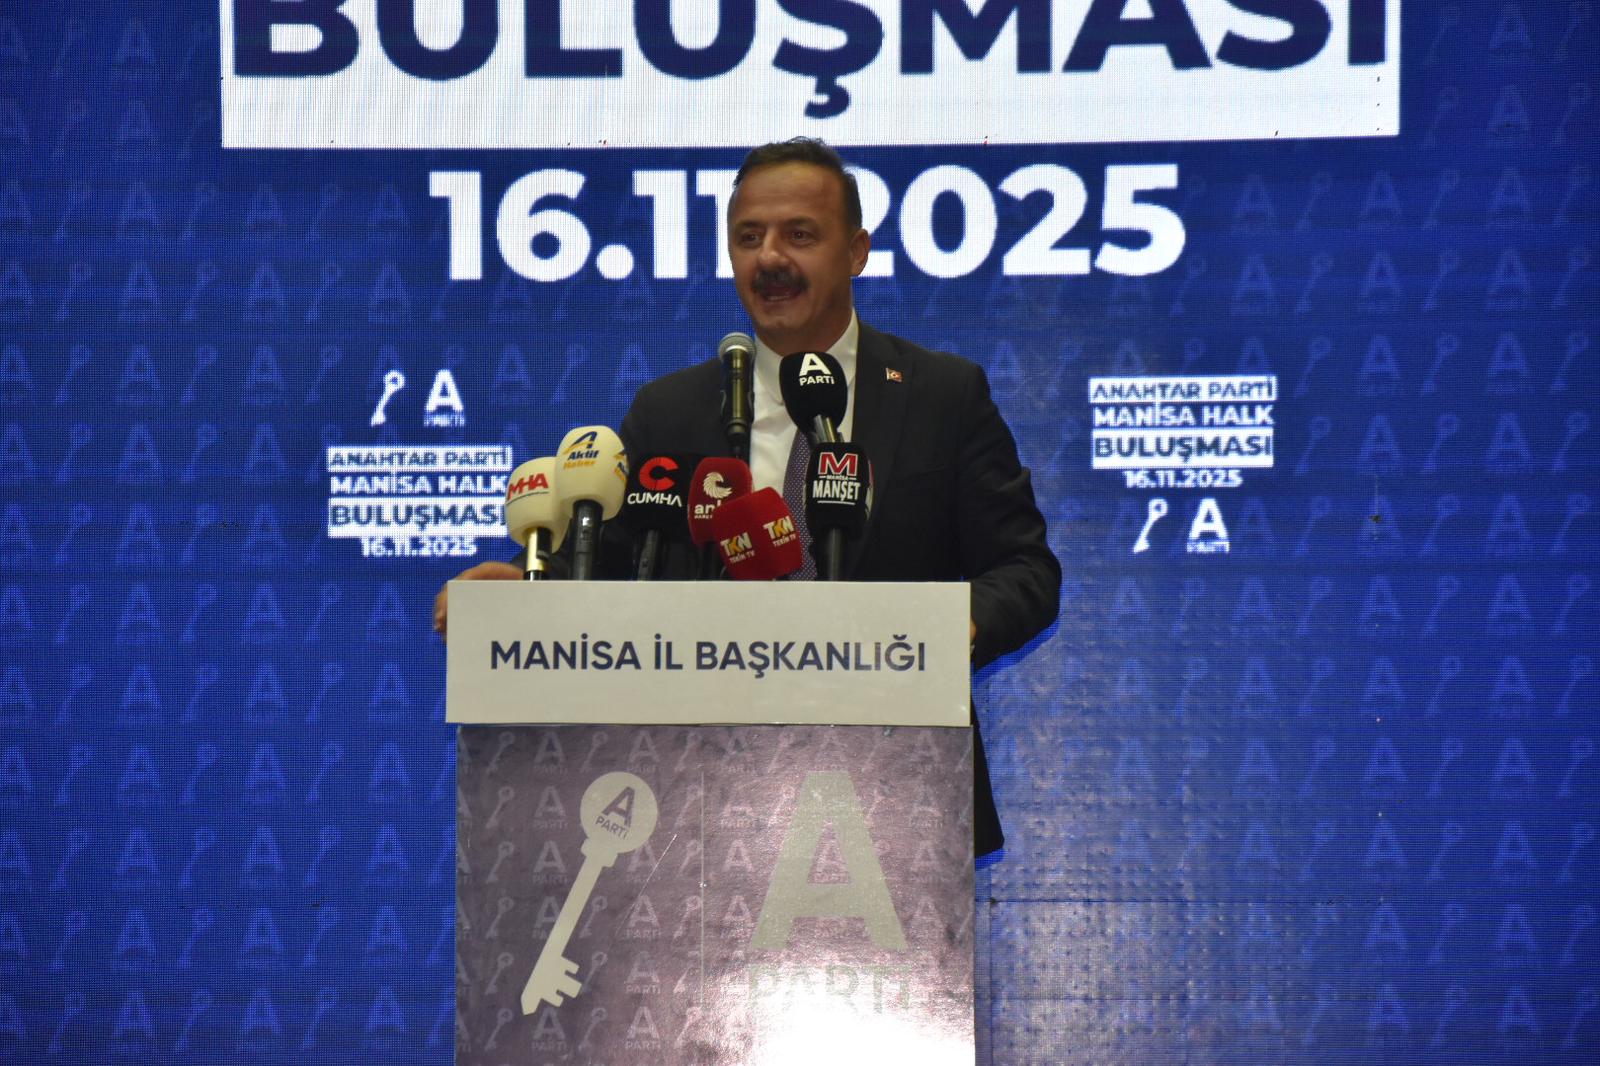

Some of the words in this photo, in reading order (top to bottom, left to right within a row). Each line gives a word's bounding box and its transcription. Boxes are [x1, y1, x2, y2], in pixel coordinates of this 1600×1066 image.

[799, 353, 832, 376] A
[1093, 382, 1200, 399] ANAHTAR
[1094, 402, 1196, 427] MANİSA
[1202, 405, 1274, 425] HALK
[330, 452, 437, 466] ANAHTAR
[567, 450, 599, 460] Aktif
[1095, 436, 1271, 463] BULUŞMASI
[818, 452, 858, 476] M
[331, 472, 432, 494] MANİSA
[438, 475, 508, 494] HALK
[508, 473, 549, 500] MHA
[1122, 469, 1243, 488] 16.11.2025
[627, 492, 682, 507] CUMHA
[812, 480, 861, 501] MANŞET
[763, 516, 794, 540] TKN
[360, 536, 477, 557] 16.11.2025
[720, 532, 753, 557] TKN
[491, 633, 641, 670] MANİSA
[654, 633, 683, 670] İL
[696, 634, 925, 679] BAŞKANLIĞI
[601, 786, 635, 828] A
